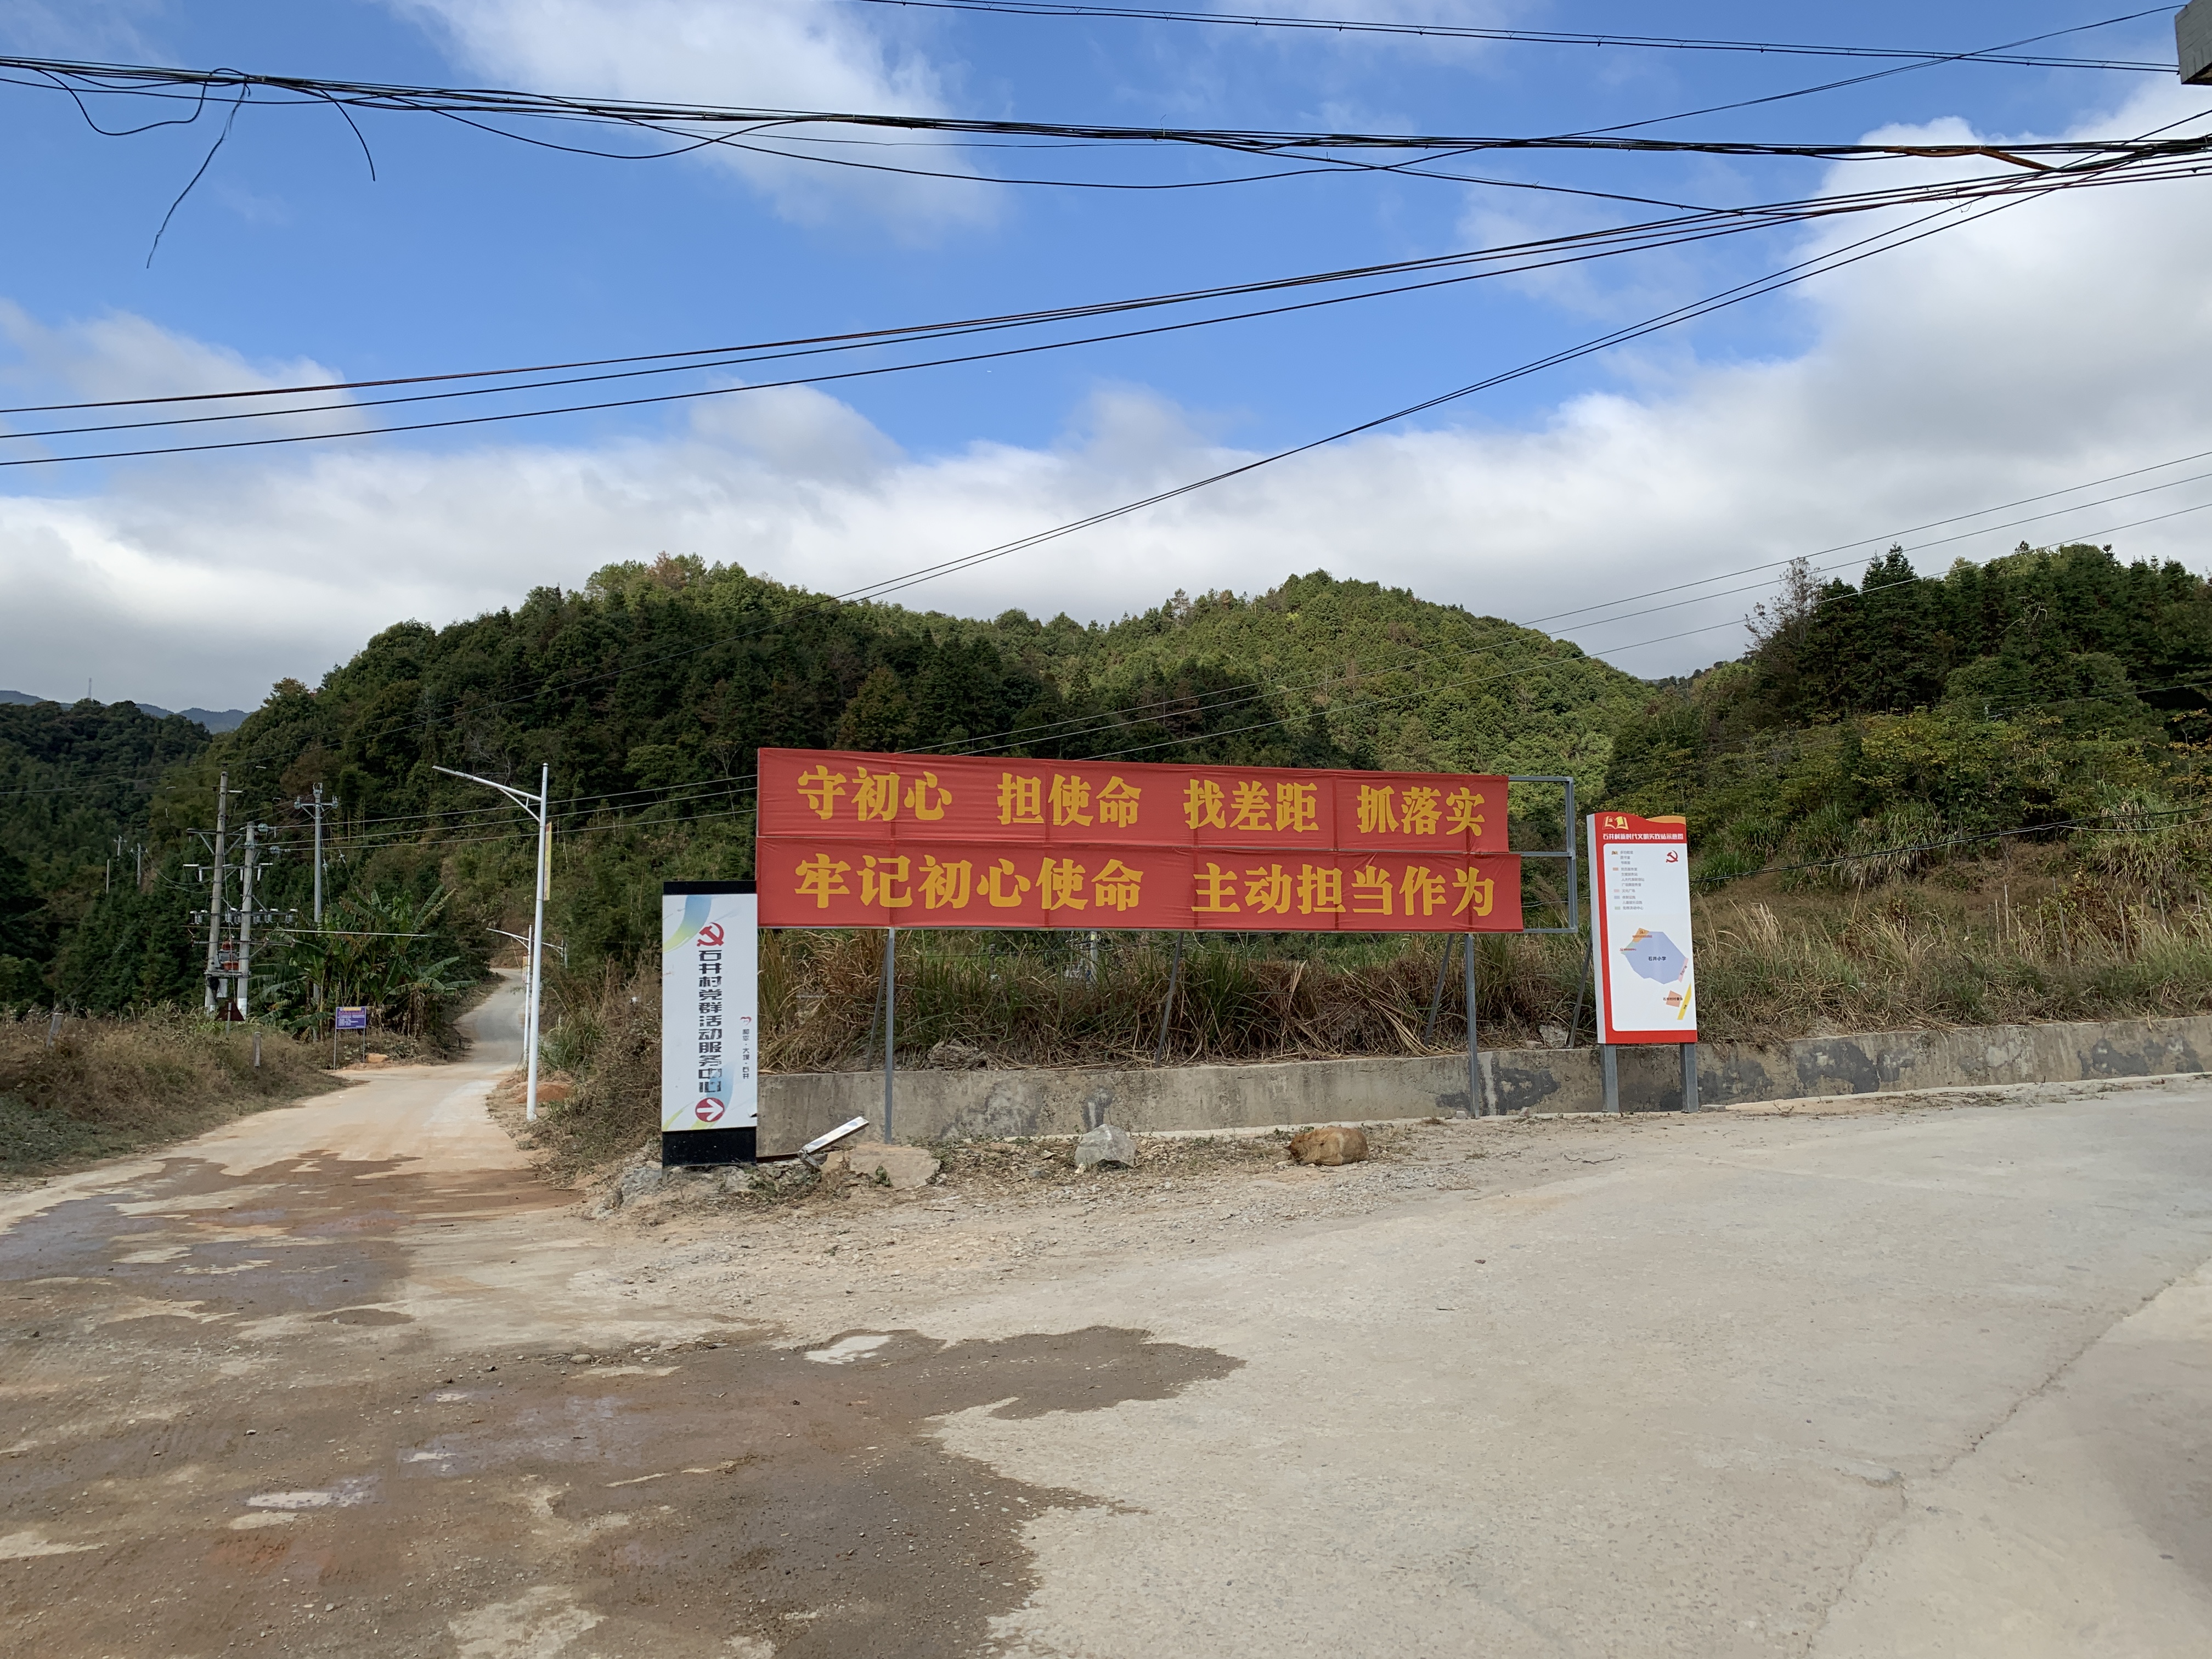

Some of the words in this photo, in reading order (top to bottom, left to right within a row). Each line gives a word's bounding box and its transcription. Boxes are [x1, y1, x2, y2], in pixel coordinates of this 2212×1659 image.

[797, 765, 952, 821] 守初心
[997, 772, 1142, 828] 担使命
[1183, 778, 1319, 833] 找差距
[1356, 785, 1486, 837] 抓落实
[794, 853, 1144, 912] 牢记初心使命
[1191, 862, 1494, 917] 主动担当作为
[698, 950, 723, 1093] 石井村党群活动服务中心
